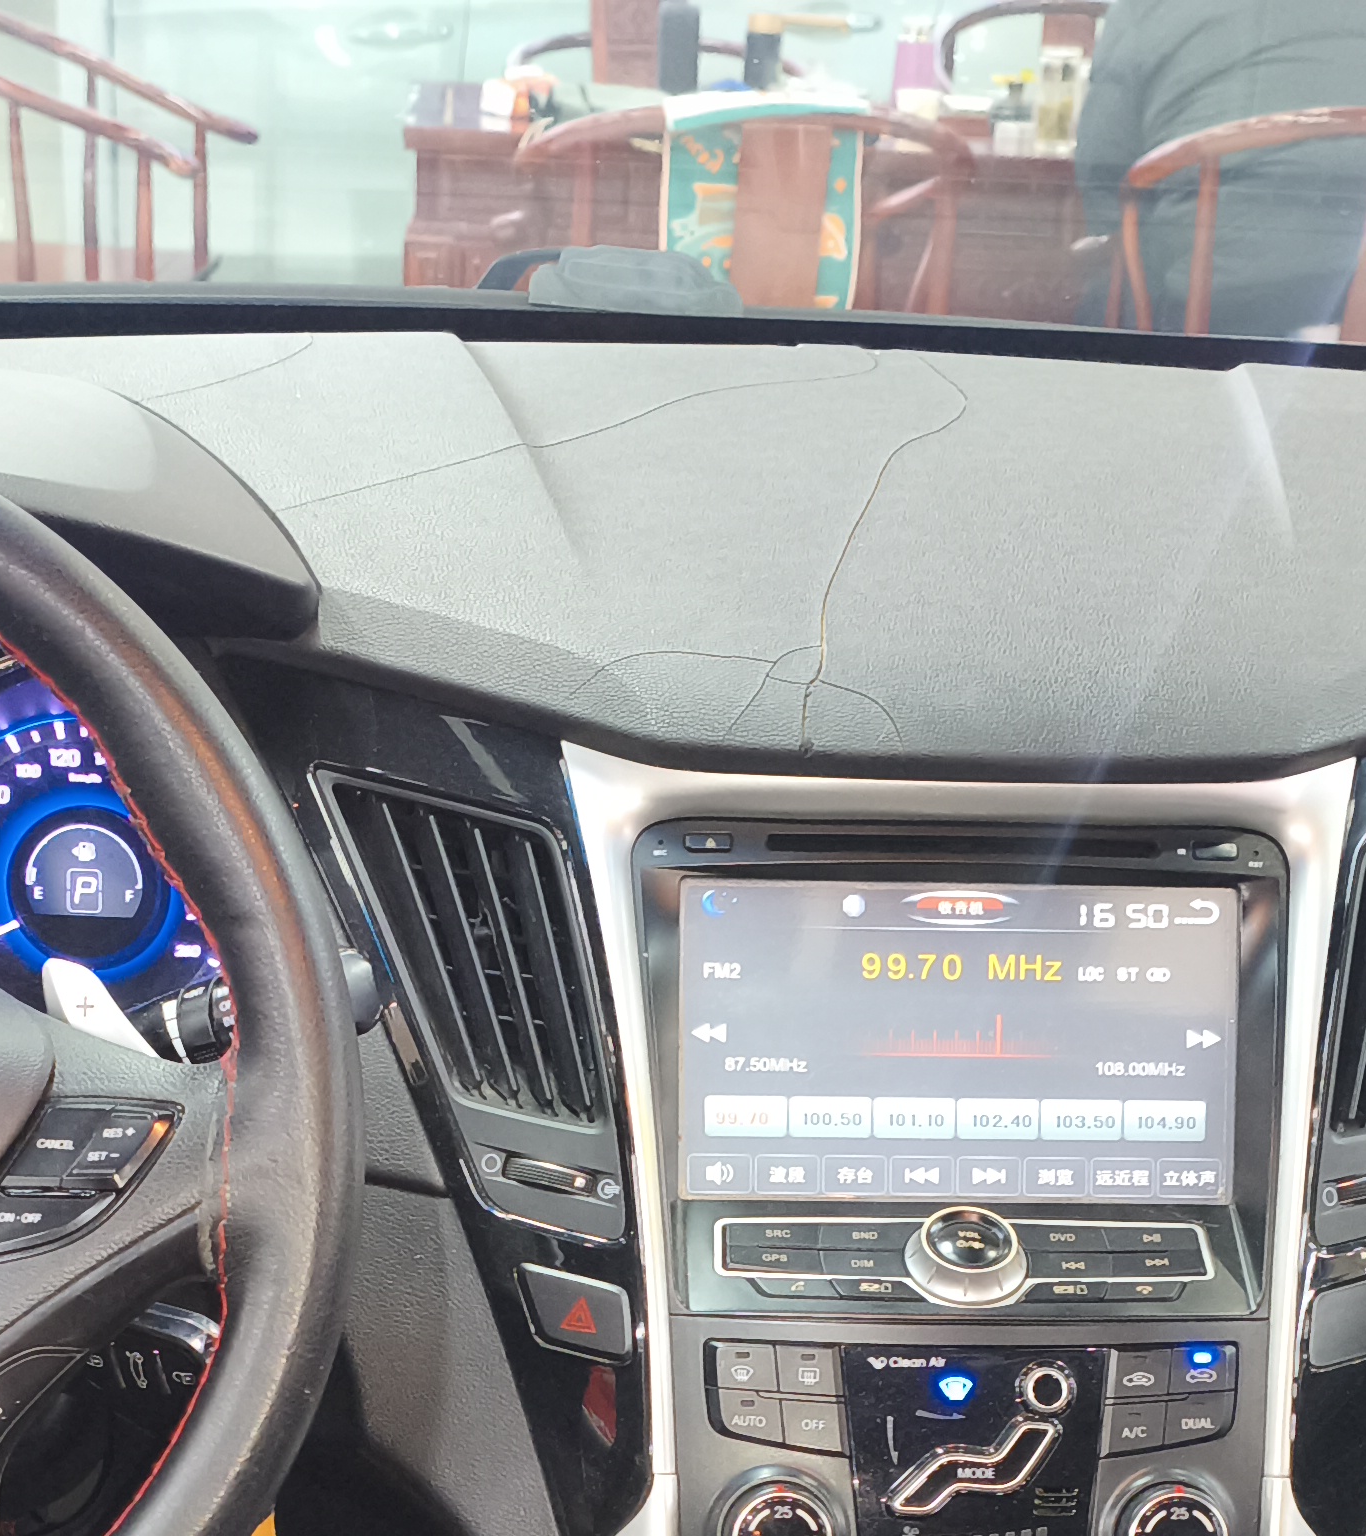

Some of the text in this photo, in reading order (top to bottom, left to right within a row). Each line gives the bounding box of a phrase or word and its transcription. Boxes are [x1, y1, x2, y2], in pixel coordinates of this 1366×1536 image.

[48, 748, 81, 767] 120
[33, 886, 43, 900] E
[74, 876, 98, 904] P
[125, 889, 135, 903] F
[938, 901, 984, 915] 收音机
[702, 961, 741, 979] FM2
[861, 952, 1062, 981] 99.70 MHz
[724, 1057, 808, 1073] 87.50MHz
[1095, 1061, 1186, 1077] 108.00MHz
[803, 1112, 862, 1126] 100.50
[889, 1113, 945, 1127] 101.10
[972, 1114, 1032, 1129] 102.40
[1056, 1115, 1116, 1130] 103.50
[1137, 1116, 1197, 1130] 104.90
[769, 1165, 806, 1184] 波段
[837, 1166, 874, 1184] 存台
[1037, 1168, 1074, 1186] 浏览
[1095, 1169, 1150, 1187] 远近程
[1162, 1169, 1217, 1187] 立体声
[765, 1229, 791, 1238] SRC
[852, 1231, 878, 1240] BND
[1050, 1233, 1075, 1242] DVD
[762, 1253, 788, 1262] GPS
[851, 1259, 874, 1268] DIM
[889, 1356, 947, 1368] Clean Air
[731, 1415, 766, 1428] AUTO
[801, 1419, 826, 1431] OFF
[1181, 1417, 1215, 1430] DUAL
[1121, 1426, 1147, 1439] A/C
[957, 1467, 995, 1479] MODE
[774, 1505, 793, 1519] 25
[1169, 1506, 1190, 1520] 25
